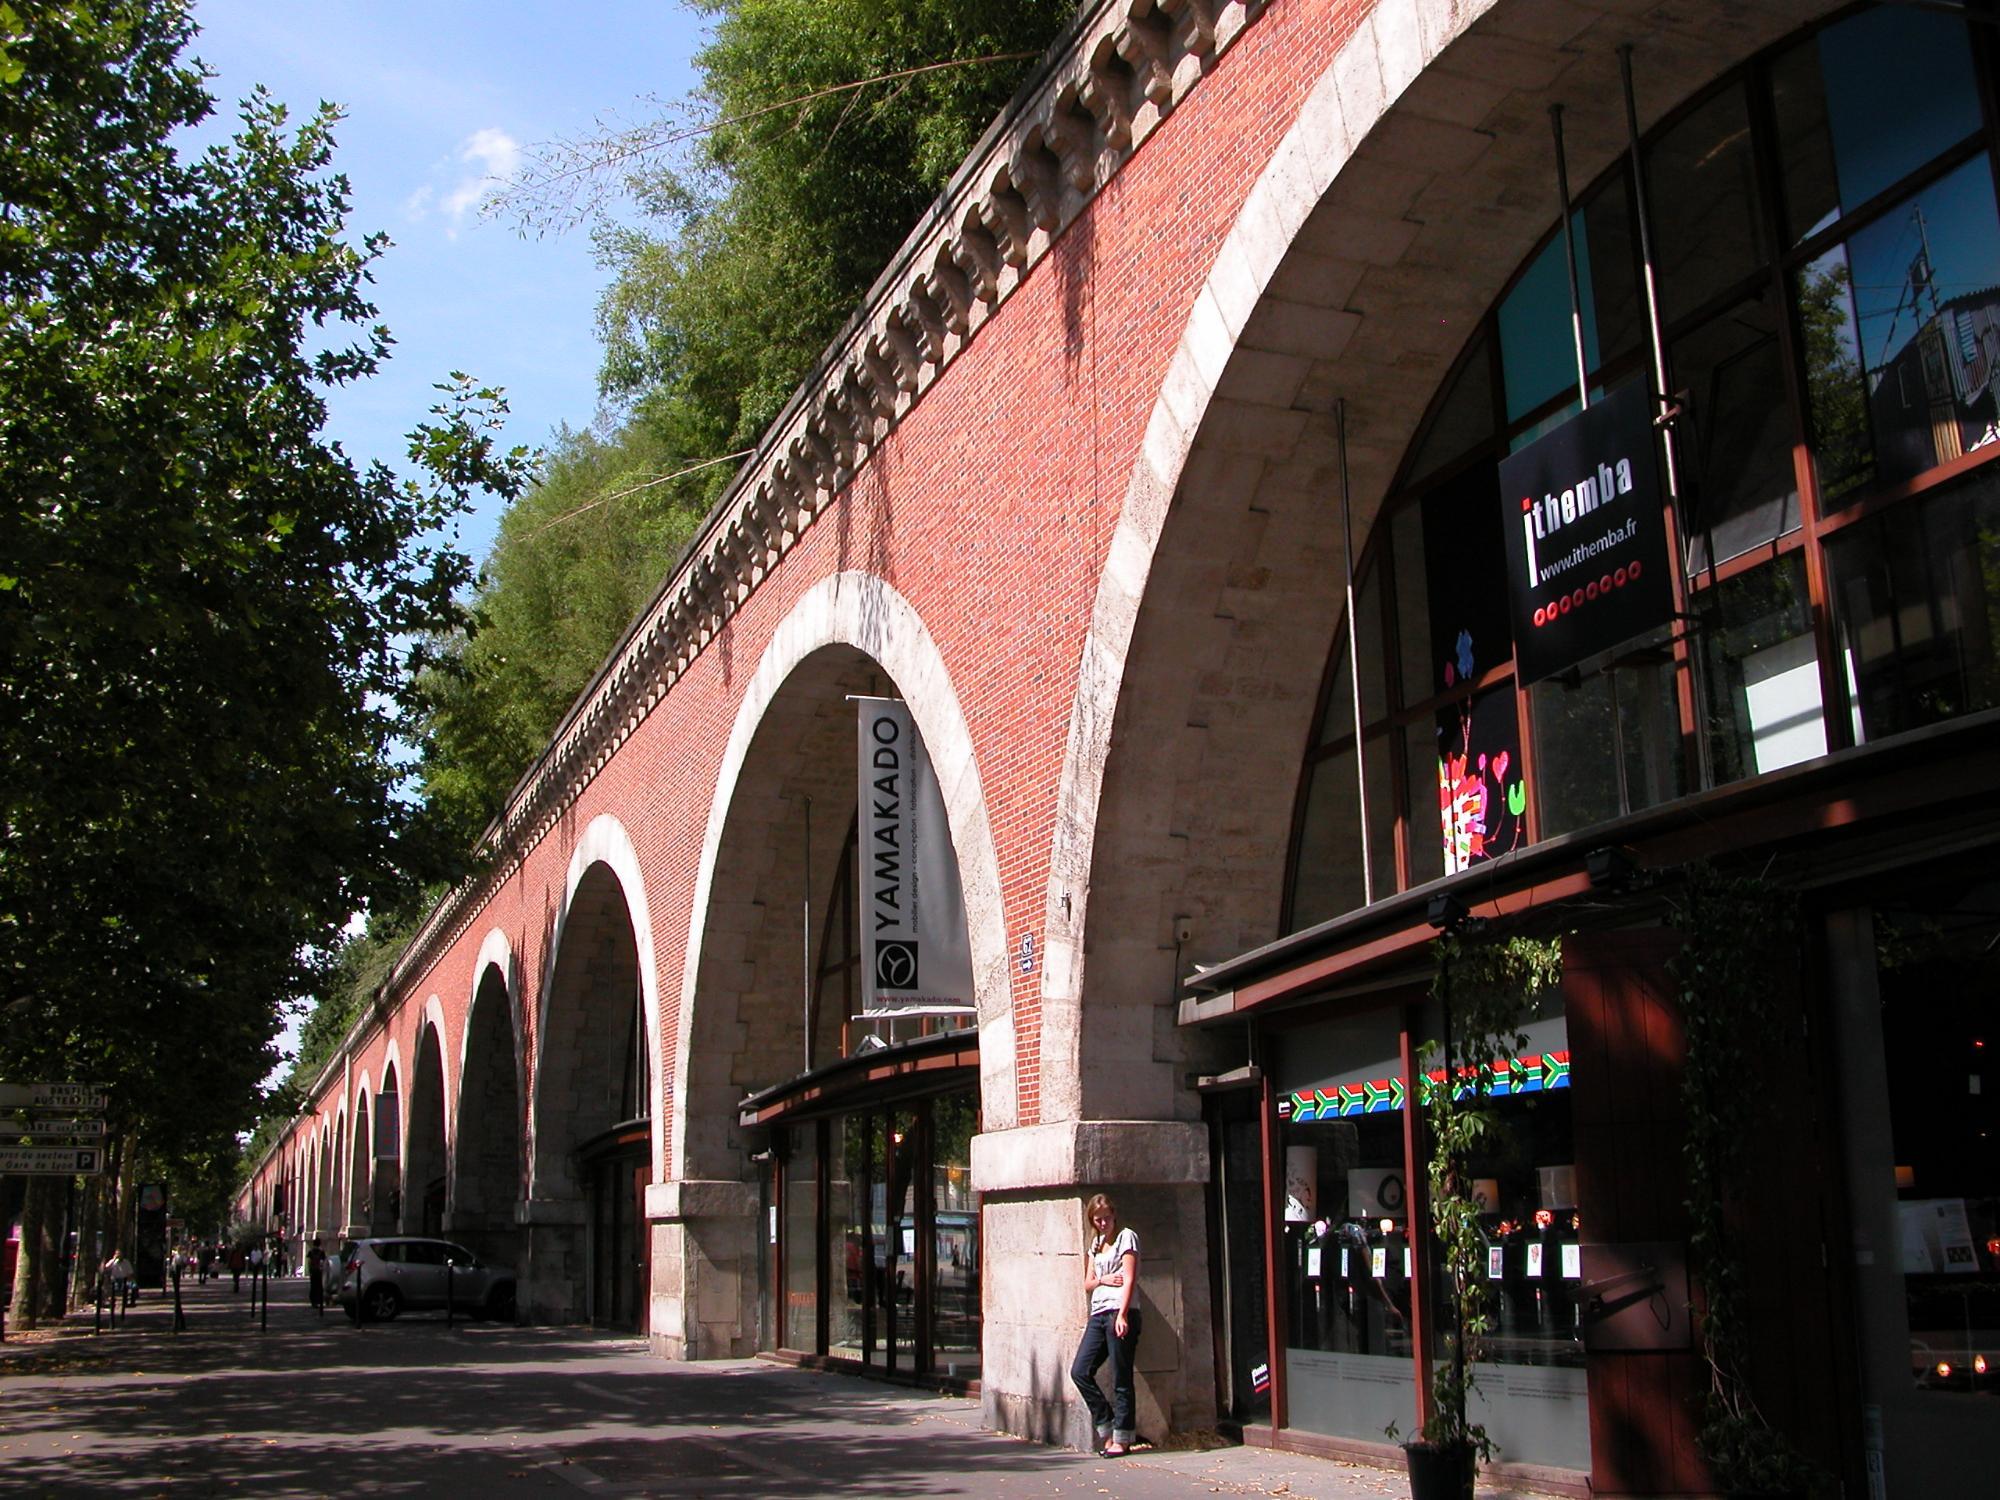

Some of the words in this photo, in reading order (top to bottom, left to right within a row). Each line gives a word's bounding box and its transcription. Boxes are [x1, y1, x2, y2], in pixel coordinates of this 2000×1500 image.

[1521, 458, 1633, 588] ithemba
[1540, 518, 1638, 582] www.ithemba.fr
[909, 768, 918, 811] fabrication
[872, 717, 900, 932] YAMAKADO
[909, 818, 918, 865] conception
[909, 871, 919, 899] design
[910, 901, 919, 933] mobilier
[34, 1096, 100, 1105] AUSTERITZ
